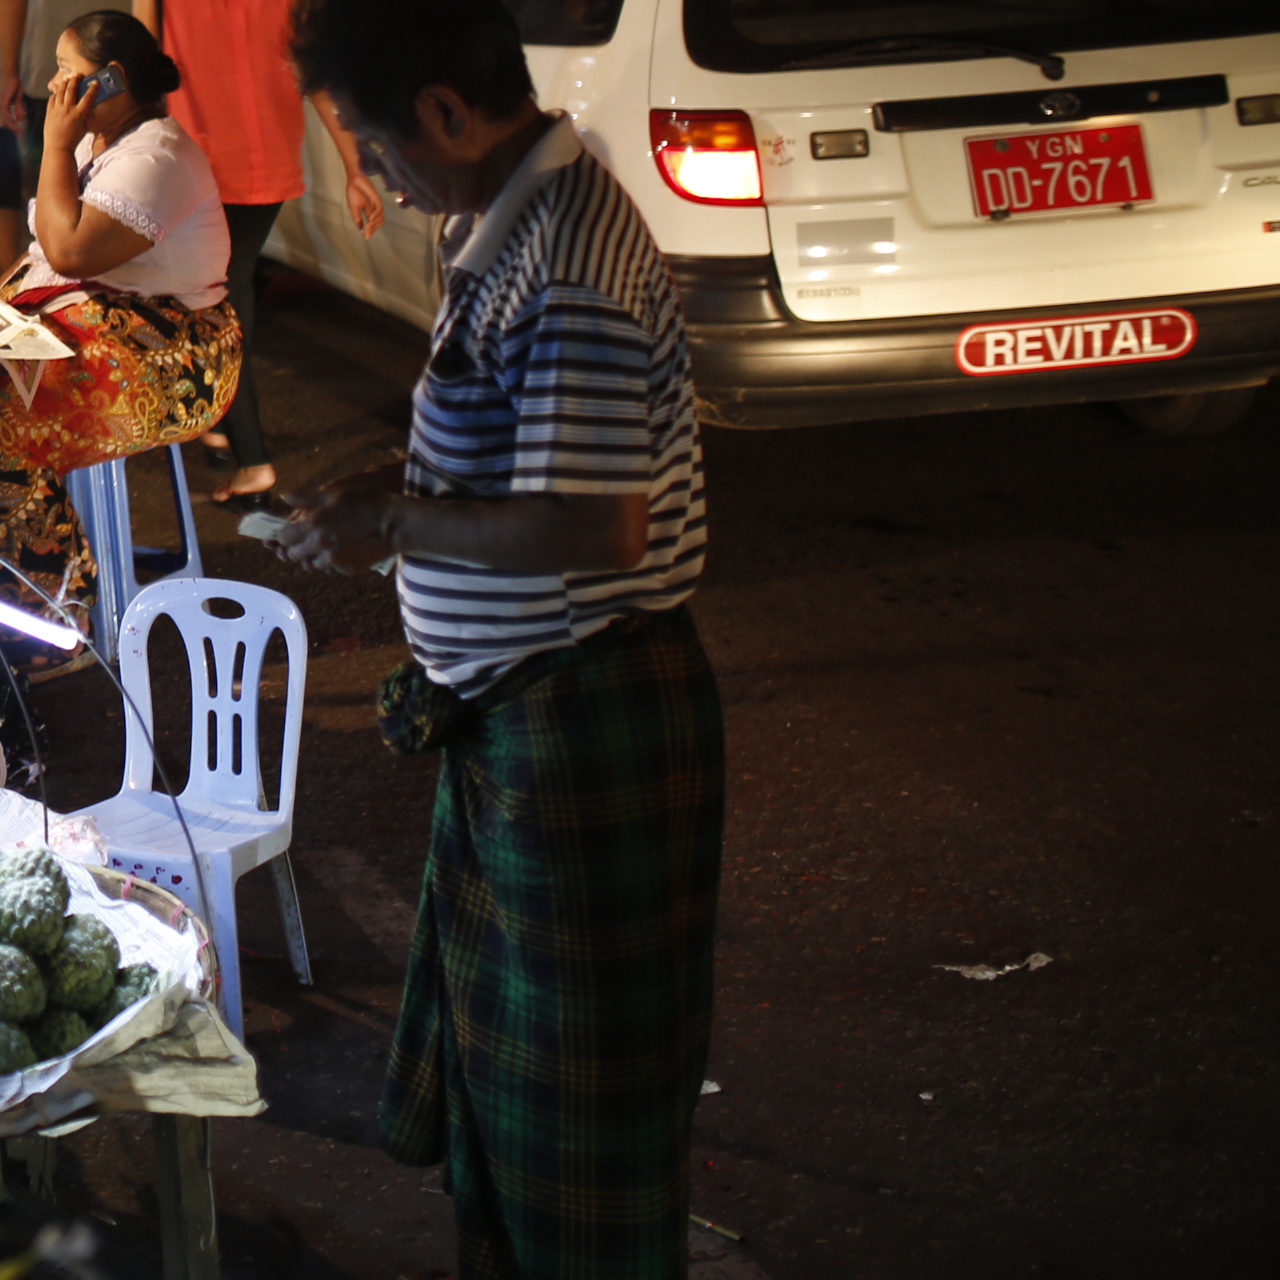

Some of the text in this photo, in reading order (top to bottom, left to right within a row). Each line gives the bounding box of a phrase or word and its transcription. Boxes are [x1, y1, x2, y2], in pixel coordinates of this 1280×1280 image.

[1025, 133, 1085, 160] YGN
[981, 155, 1138, 211] DD-7671
[984, 318, 1168, 367] REVITAL
